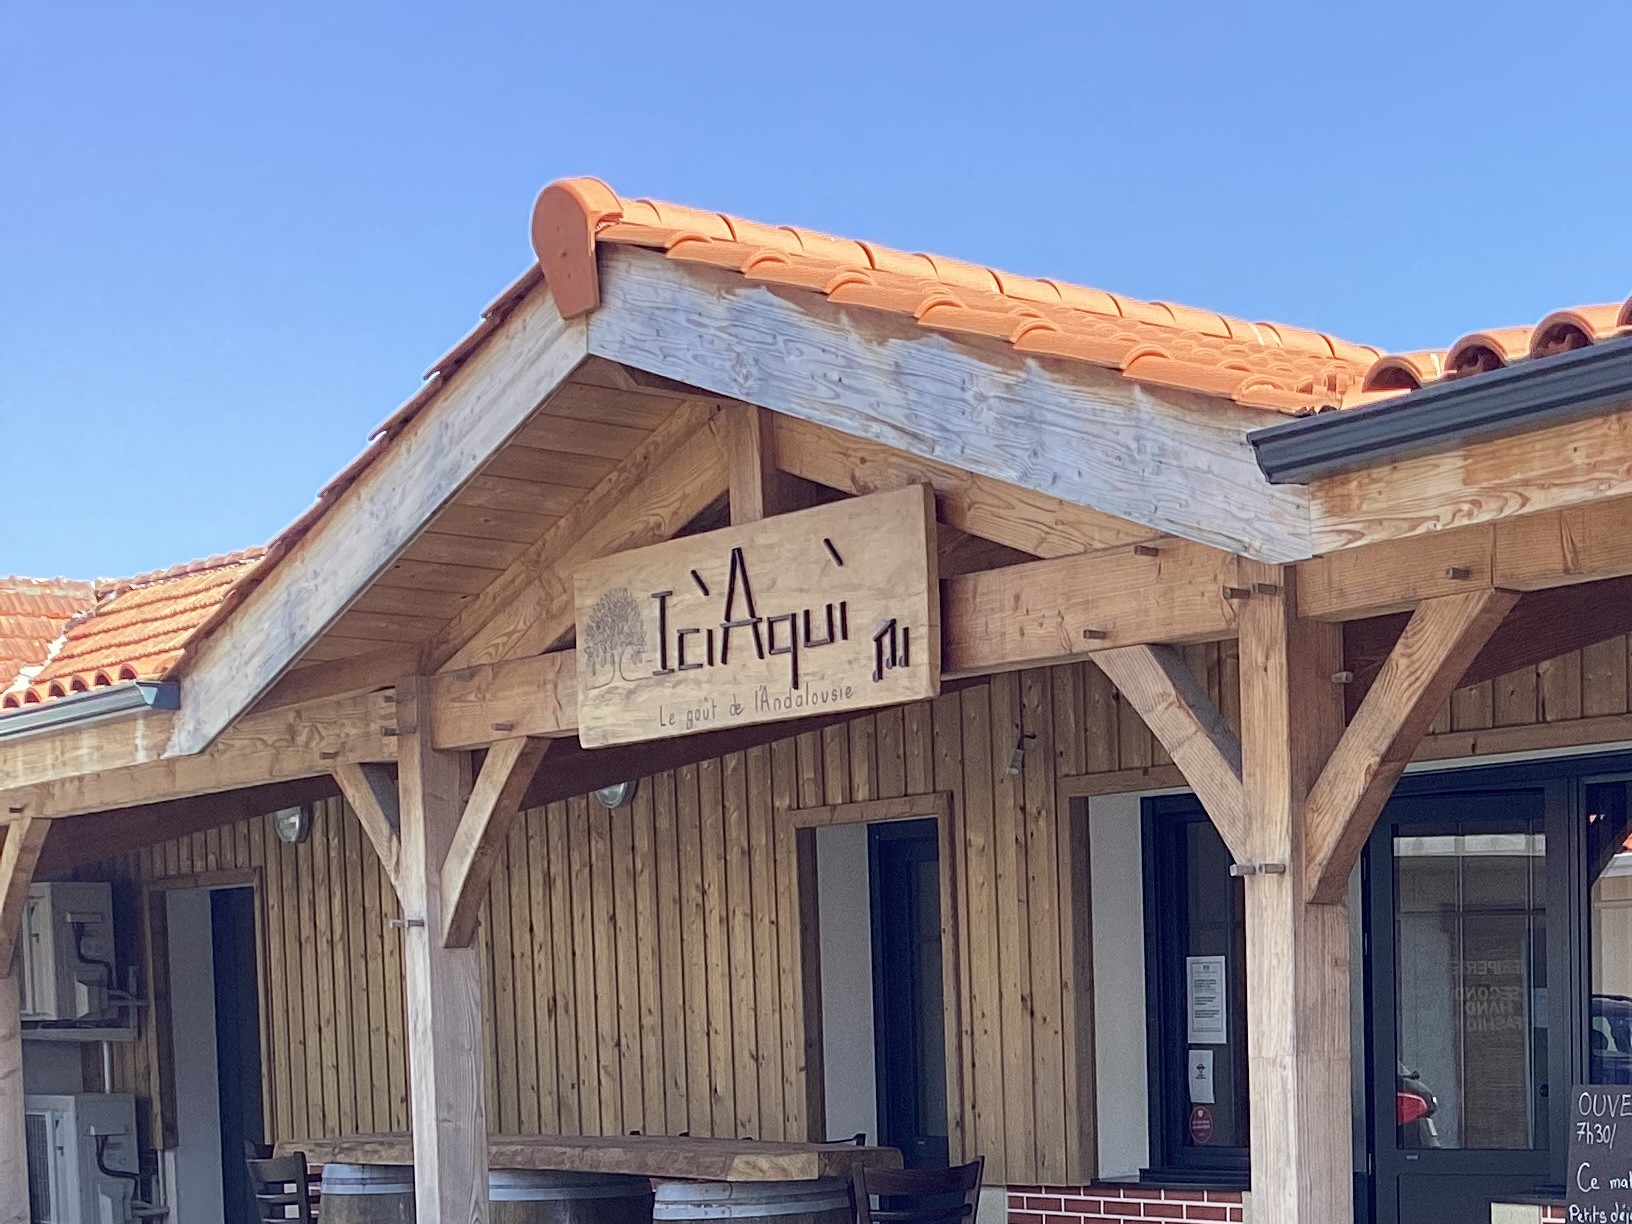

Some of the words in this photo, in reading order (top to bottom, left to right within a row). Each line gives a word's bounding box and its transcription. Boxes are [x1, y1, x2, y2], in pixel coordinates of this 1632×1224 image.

[659, 705, 675, 727] Le
[686, 697, 717, 730] goût
[729, 694, 745, 717] de
[754, 682, 854, 714] l'Andalousie
[1576, 1162, 1600, 1193] Ce
[1568, 1204, 1607, 1224] Petits
